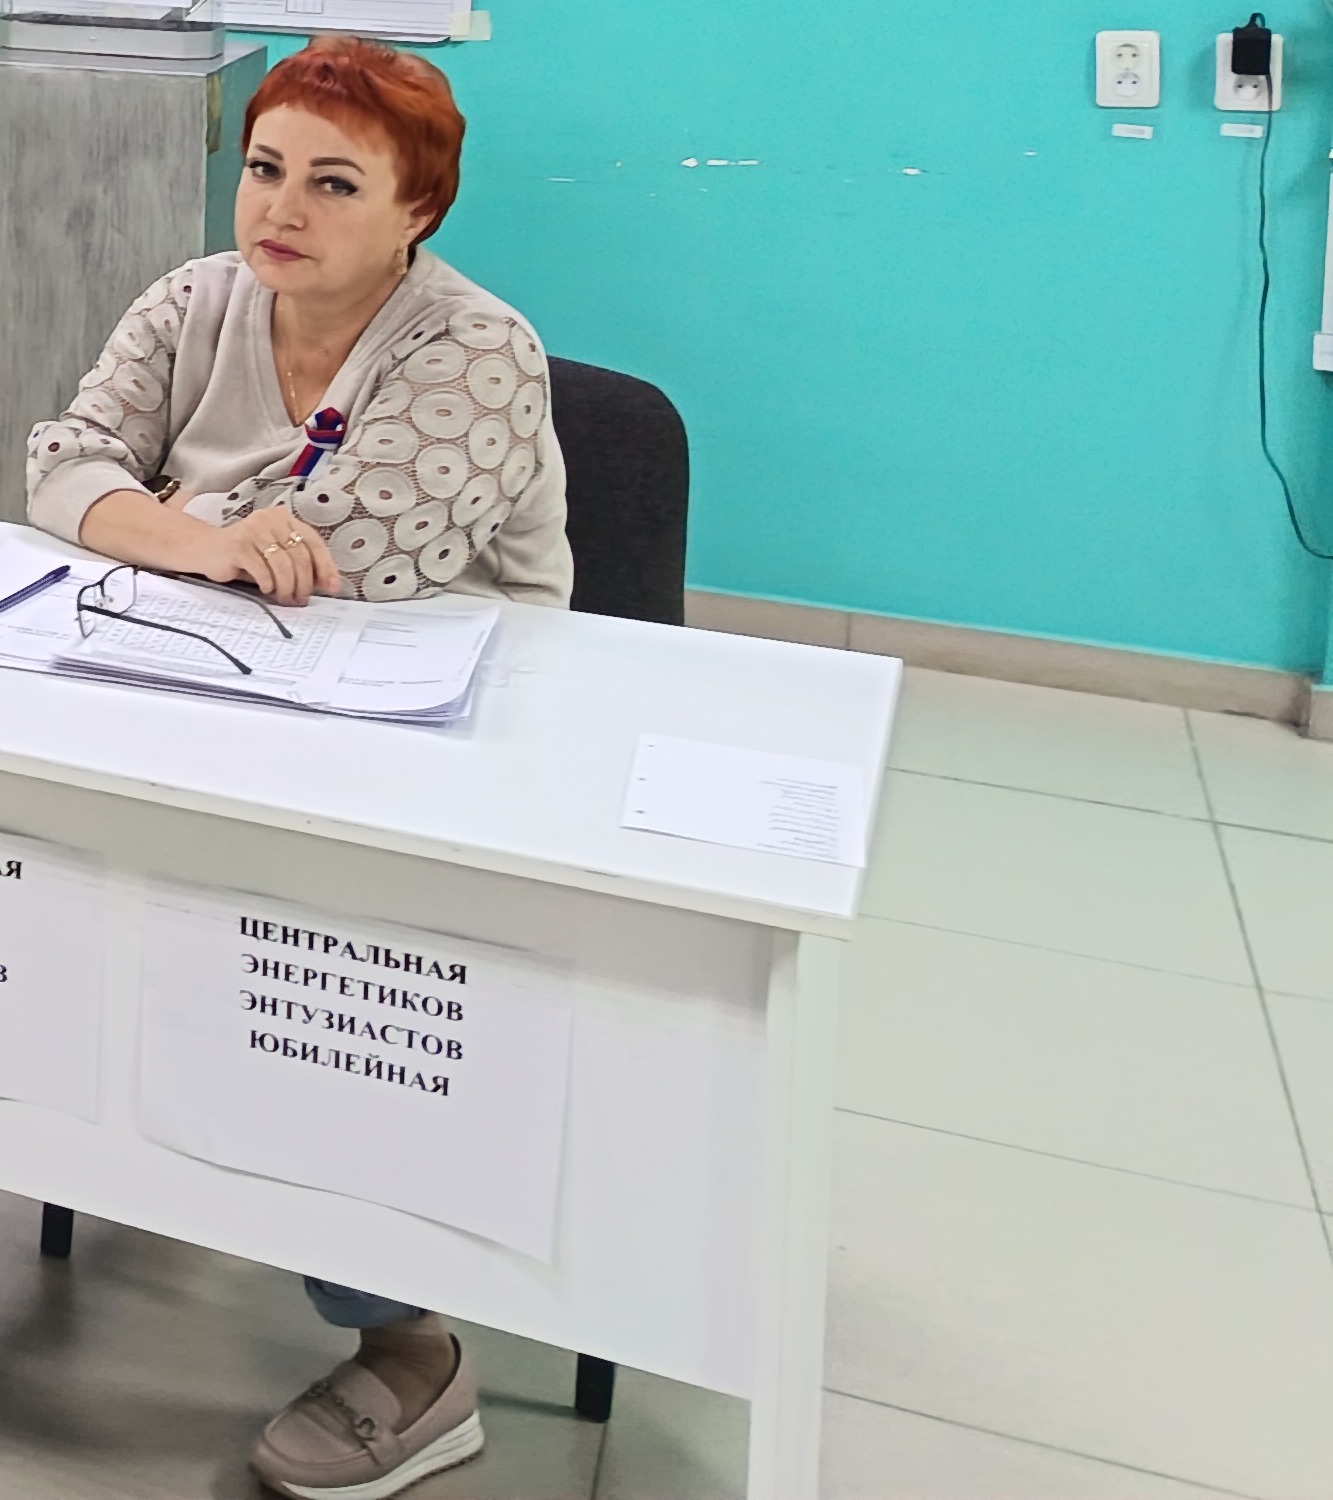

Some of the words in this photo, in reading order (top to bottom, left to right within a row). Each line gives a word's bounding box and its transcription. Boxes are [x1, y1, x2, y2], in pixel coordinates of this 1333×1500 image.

[239, 916, 468, 985] ЦЕНТРАЛЬНАЯ
[241, 953, 464, 1022] ЭНЕРГЕТИКОВ
[239, 990, 464, 1061] ЭНТУЗИАСТОВ
[249, 1029, 450, 1097] ЮБИЛЕЙНАЯ
